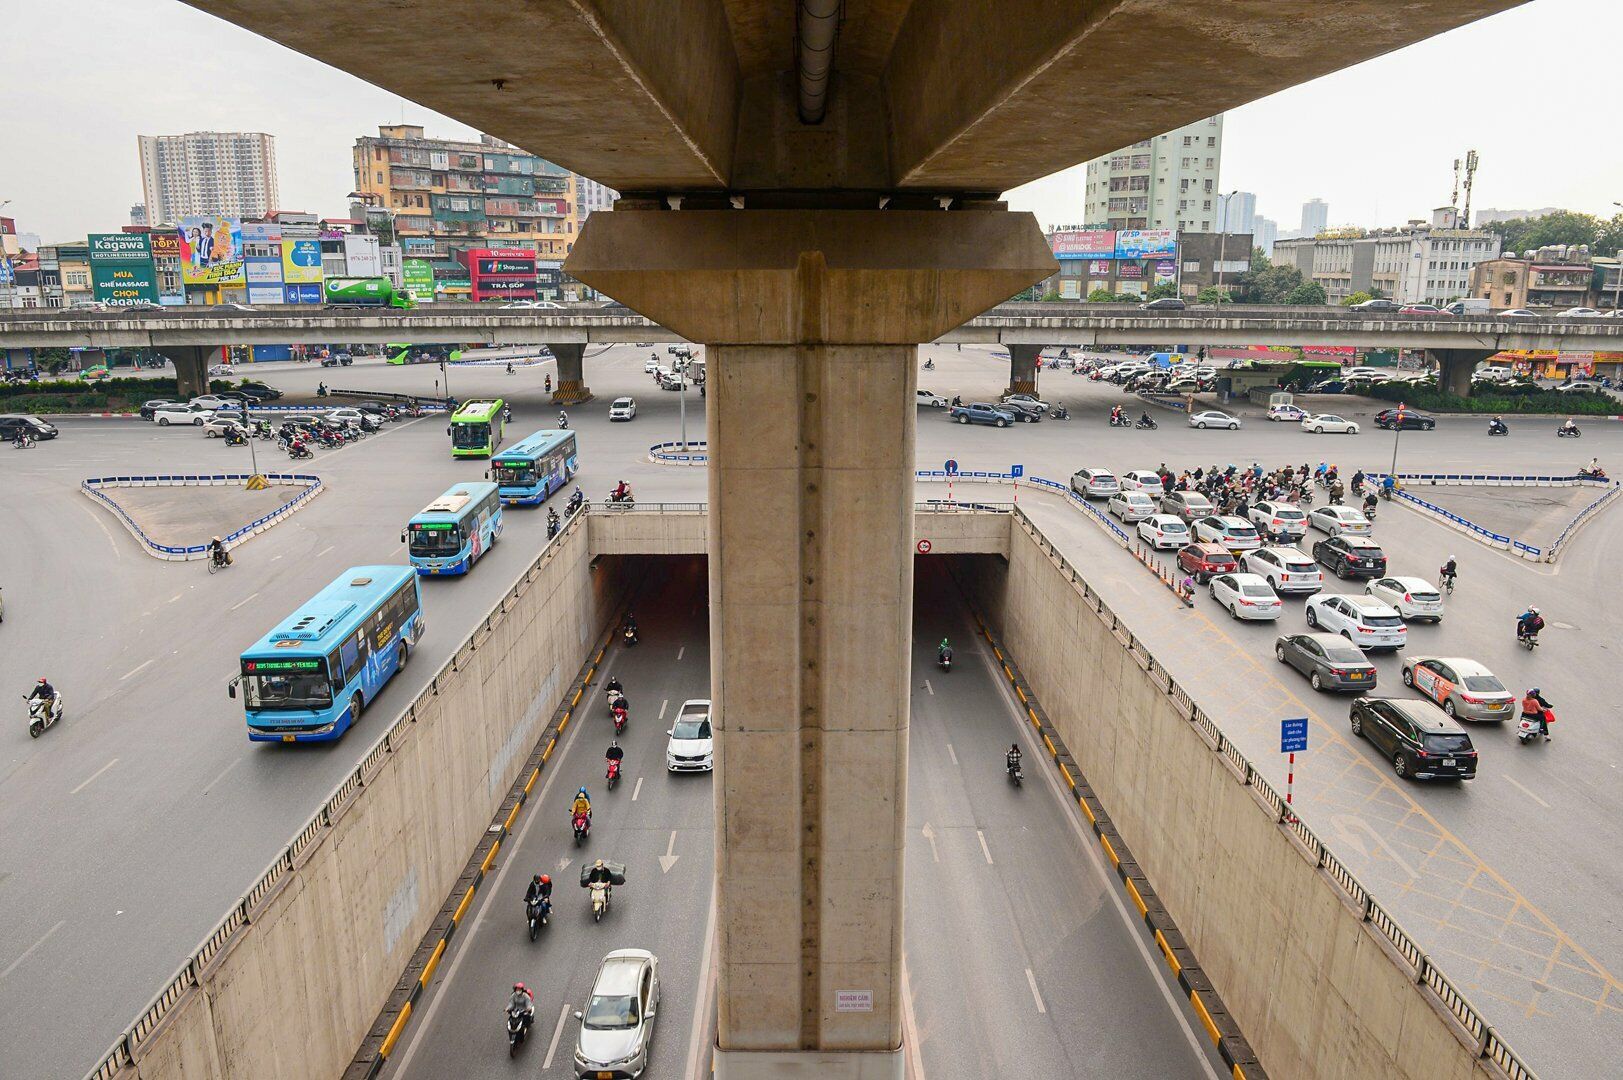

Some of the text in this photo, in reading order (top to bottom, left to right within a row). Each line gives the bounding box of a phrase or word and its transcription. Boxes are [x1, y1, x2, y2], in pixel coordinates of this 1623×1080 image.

[95, 240, 144, 251] Kagawa
[487, 261, 503, 273] FPT
[100, 280, 116, 288] GHẾ
[491, 281, 524, 289] TRẢ GÓP
[113, 290, 139, 299] CHỌN
